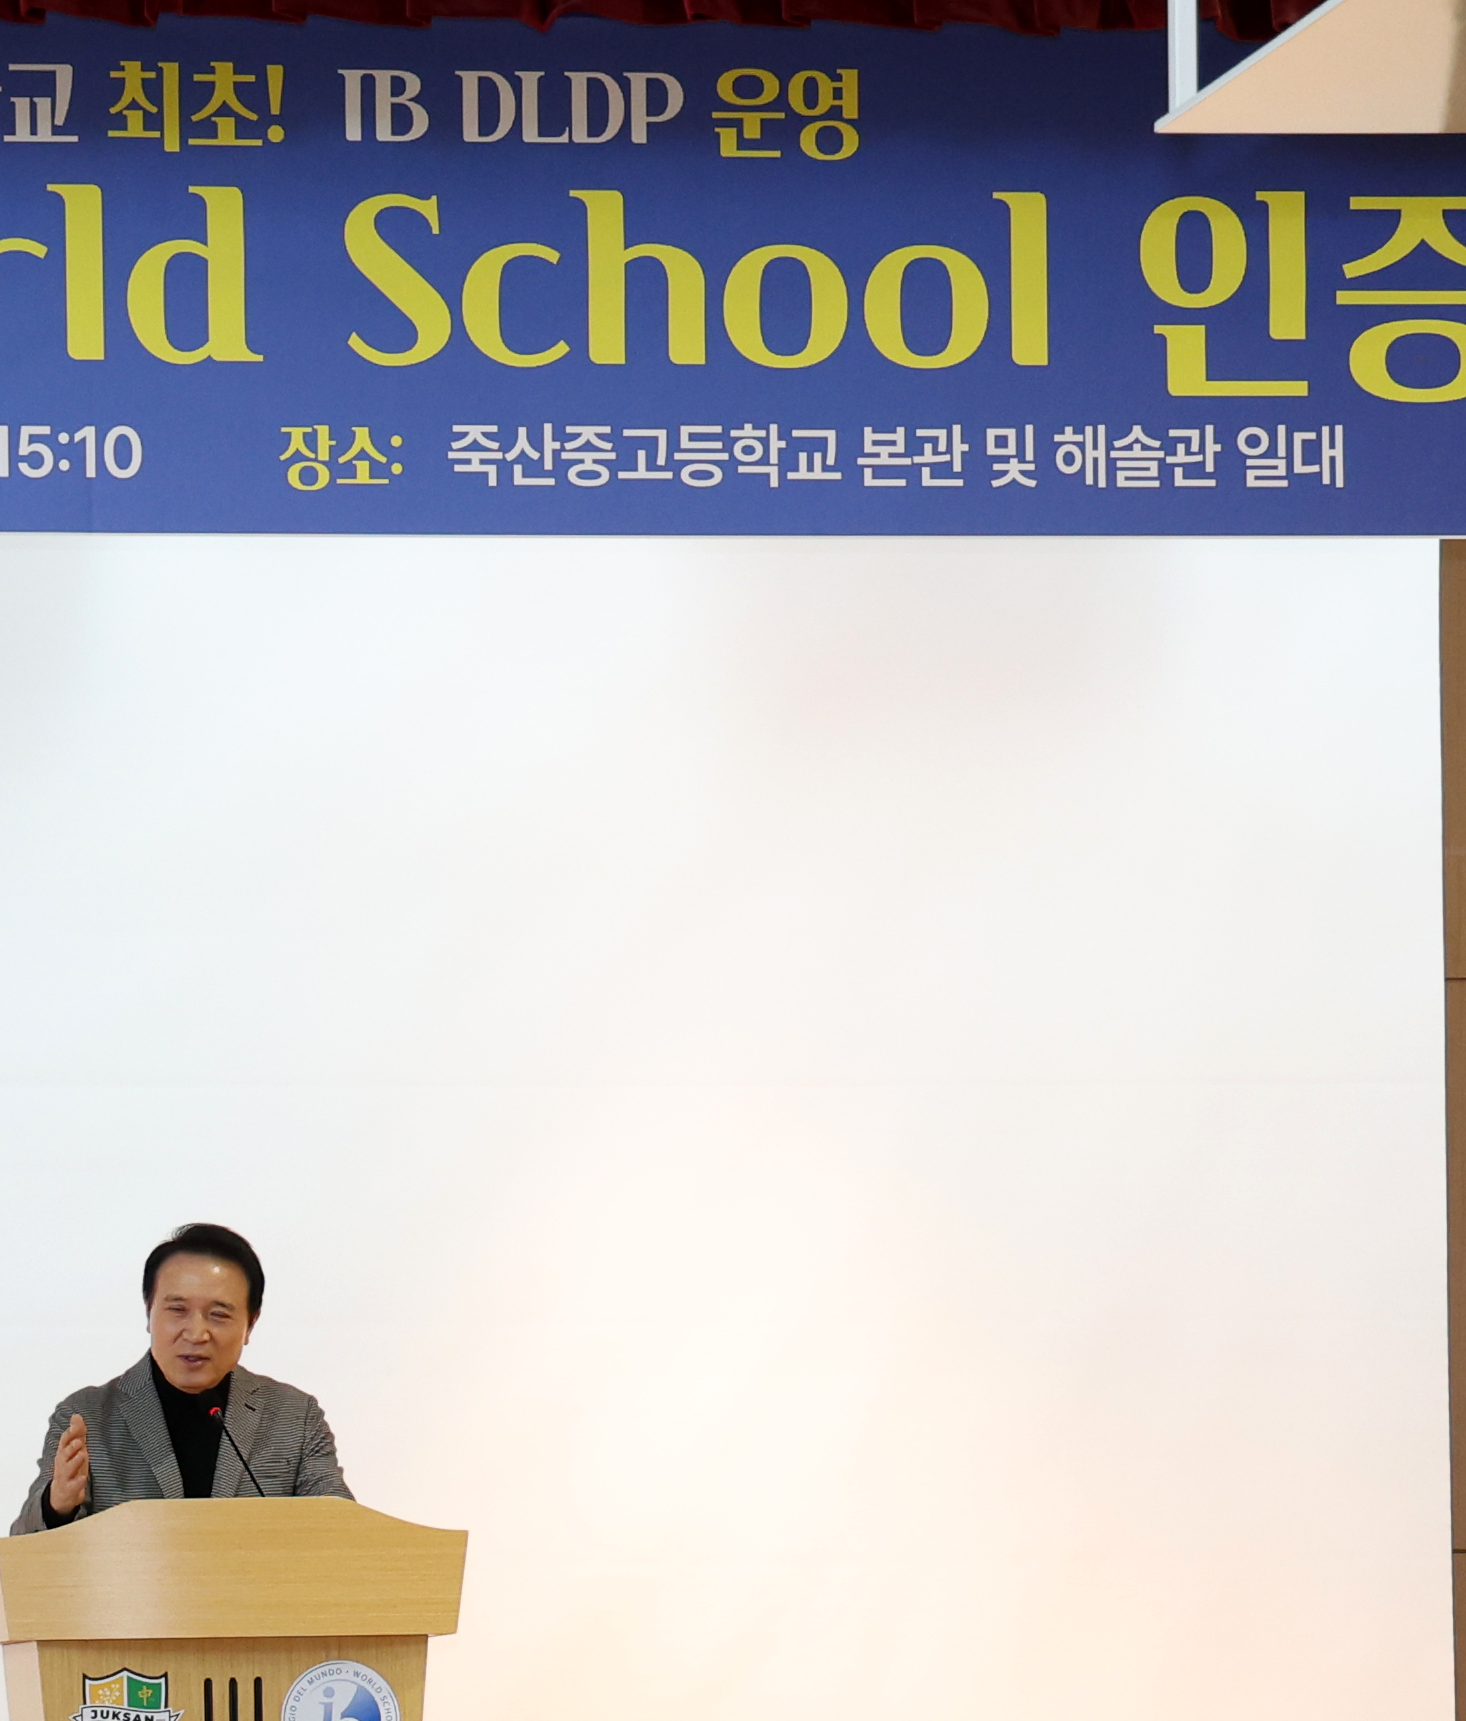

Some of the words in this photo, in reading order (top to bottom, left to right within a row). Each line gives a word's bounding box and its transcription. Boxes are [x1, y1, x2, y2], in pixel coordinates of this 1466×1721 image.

[108, 61, 284, 152] 최초!
[338, 70, 428, 141] IB
[455, 71, 683, 143] DLDP
[712, 69, 858, 160] 운영
[344, 190, 1048, 369] School
[279, 425, 403, 490] 장소:
[448, 423, 842, 487] 죽산중고등학교
[857, 424, 969, 486] 본관
[986, 424, 1037, 487] 및
[1054, 425, 1221, 488] 해솔관
[1237, 425, 1344, 488] 일대
[292, 1687, 307, 1703] DEL
[306, 1667, 342, 1686] MUNDO
[352, 1669, 383, 1694] WORLD
